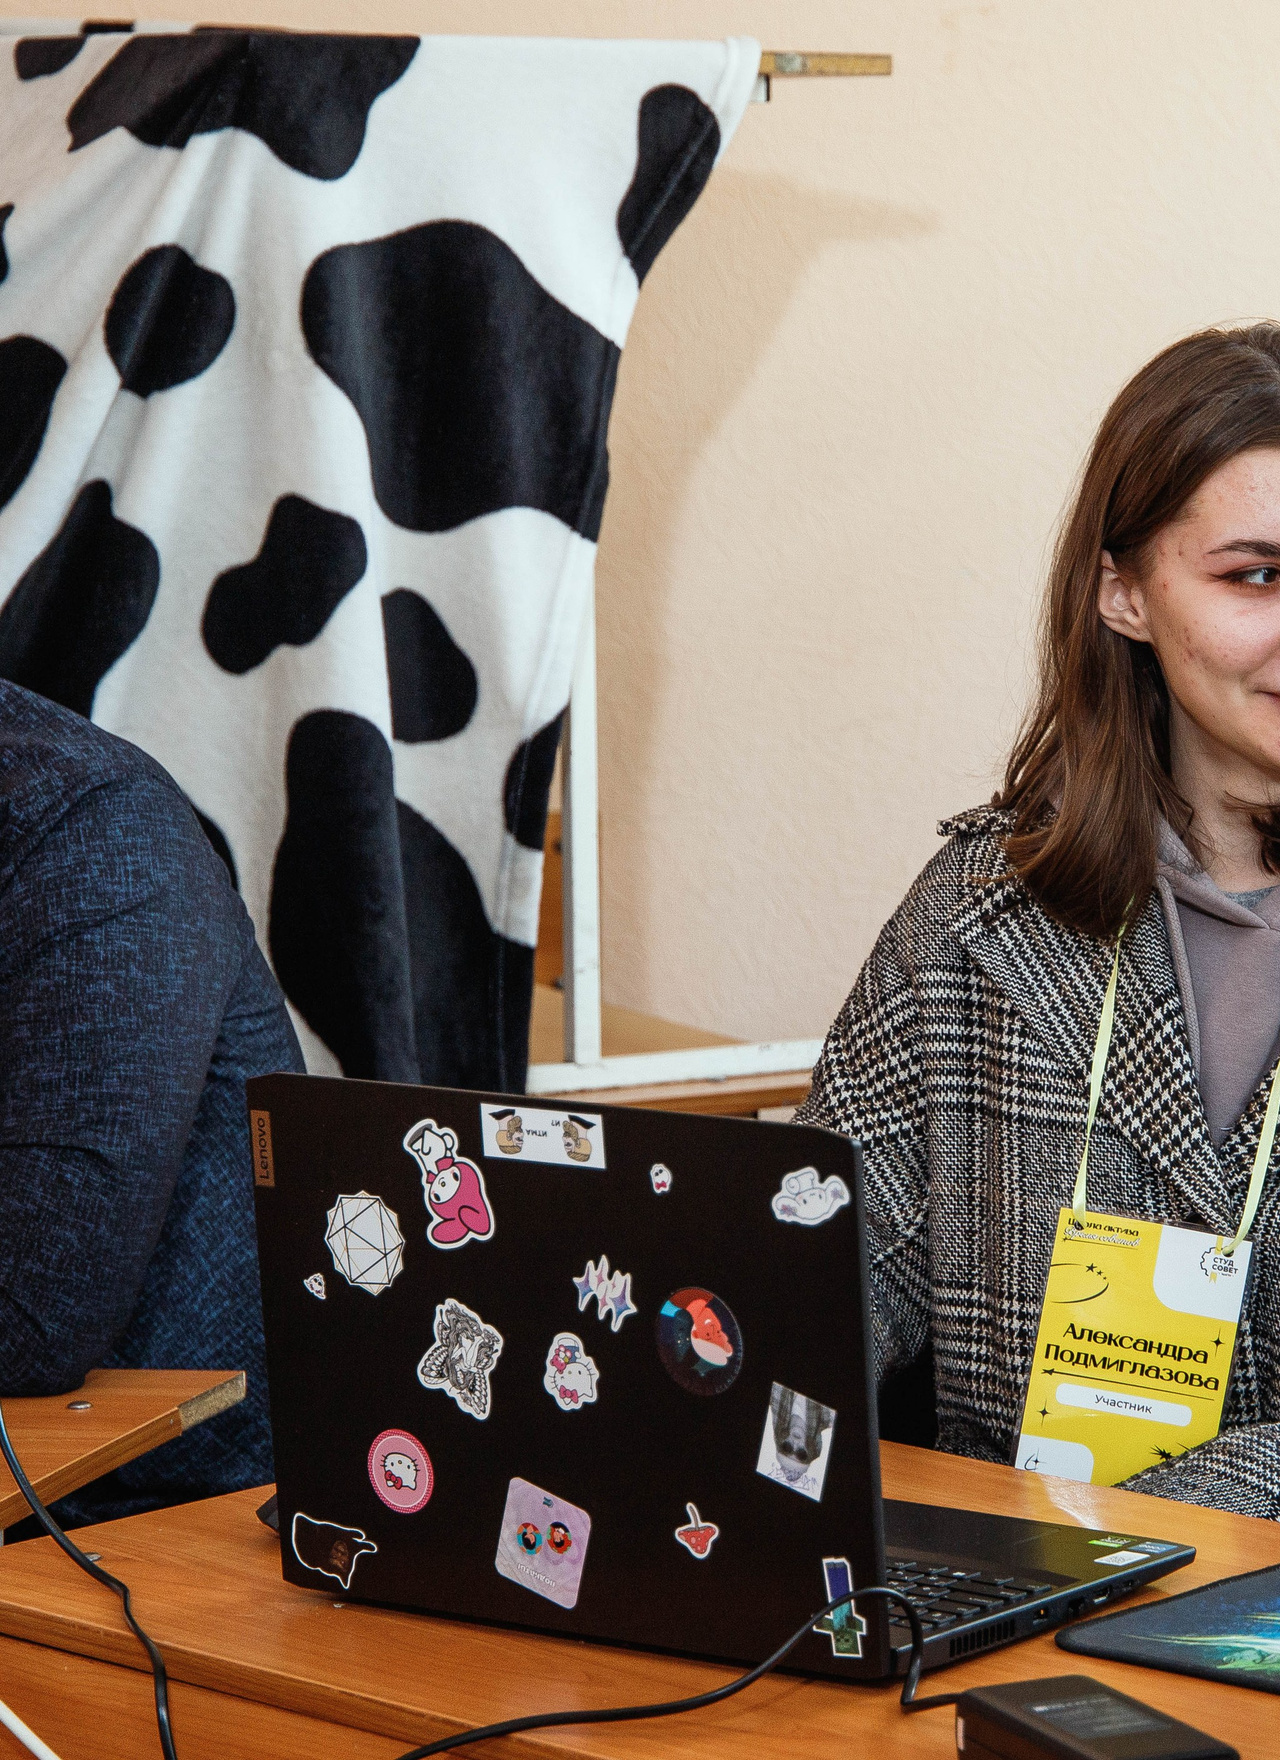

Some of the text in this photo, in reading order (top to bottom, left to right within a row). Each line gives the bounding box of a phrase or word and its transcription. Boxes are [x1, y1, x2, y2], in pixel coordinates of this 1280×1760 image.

[255, 1116, 270, 1182] Lenovo
[1068, 1217, 1102, 1231] Шола
[1211, 1263, 1239, 1275] СОВЕТ
[1213, 1256, 1235, 1267] СТУД
[1062, 1322, 1209, 1365] Александра
[1044, 1343, 1220, 1392] Подмиглазова
[1094, 1394, 1153, 1415] Участник
